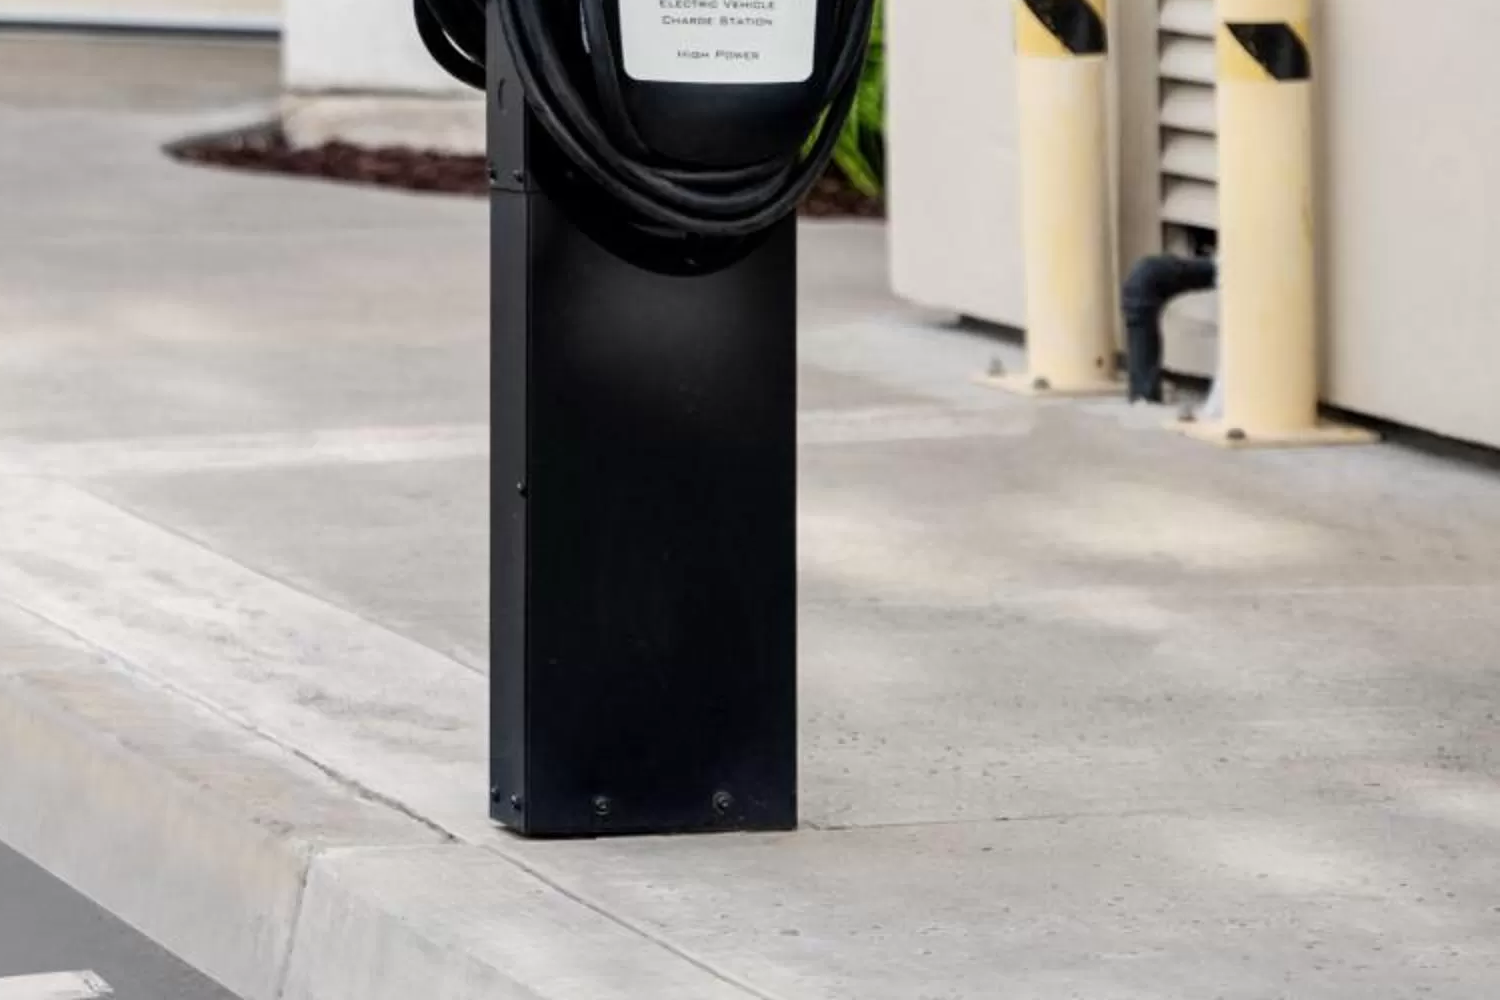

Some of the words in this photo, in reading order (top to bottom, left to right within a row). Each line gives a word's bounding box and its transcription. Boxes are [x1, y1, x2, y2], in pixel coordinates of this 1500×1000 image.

[659, 0, 718, 9] ELECTRIC
[723, 0, 775, 10] VEHICLE
[661, 15, 712, 25] CHARGE
[719, 15, 773, 26] STATION
[715, 50, 760, 61] POWER
